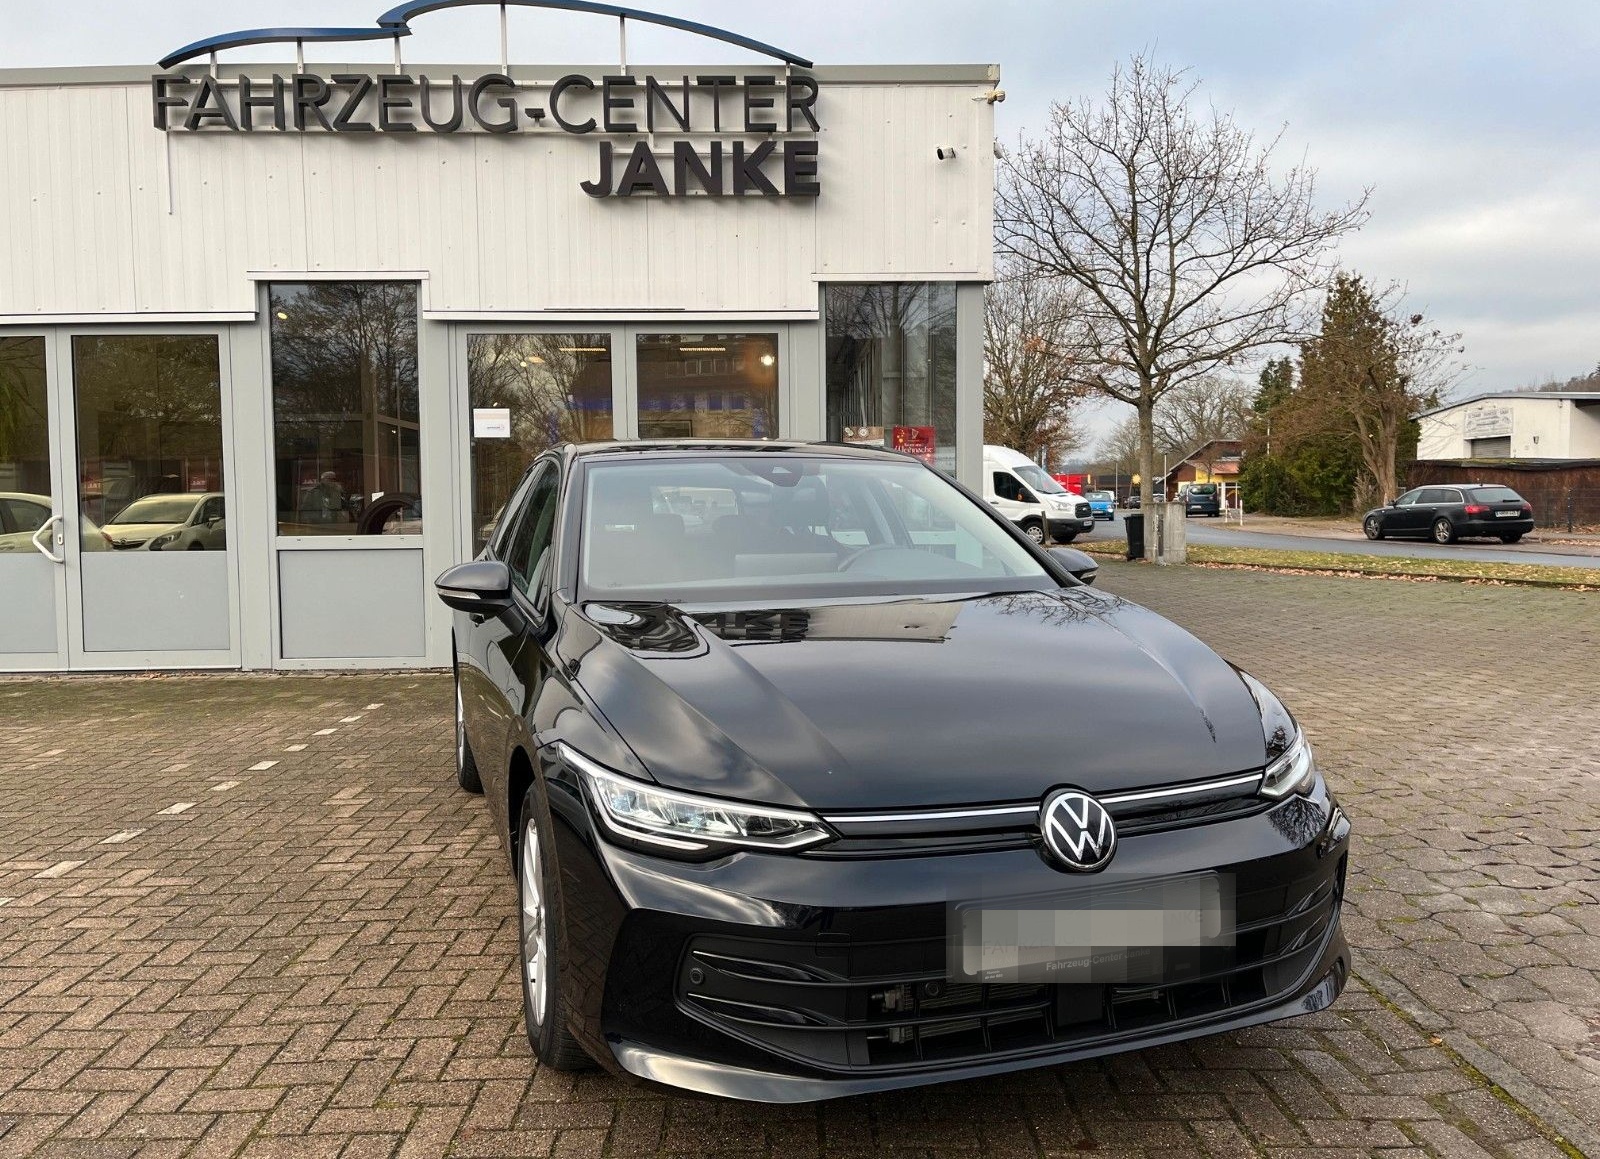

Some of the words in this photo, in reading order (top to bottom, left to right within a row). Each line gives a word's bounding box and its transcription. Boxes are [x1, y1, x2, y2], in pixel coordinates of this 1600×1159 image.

[151, 74, 820, 134] FAHRZEUG-CENTER
[580, 140, 821, 198] JANKE
[1046, 953, 1122, 971] Fahrzeug-Center
